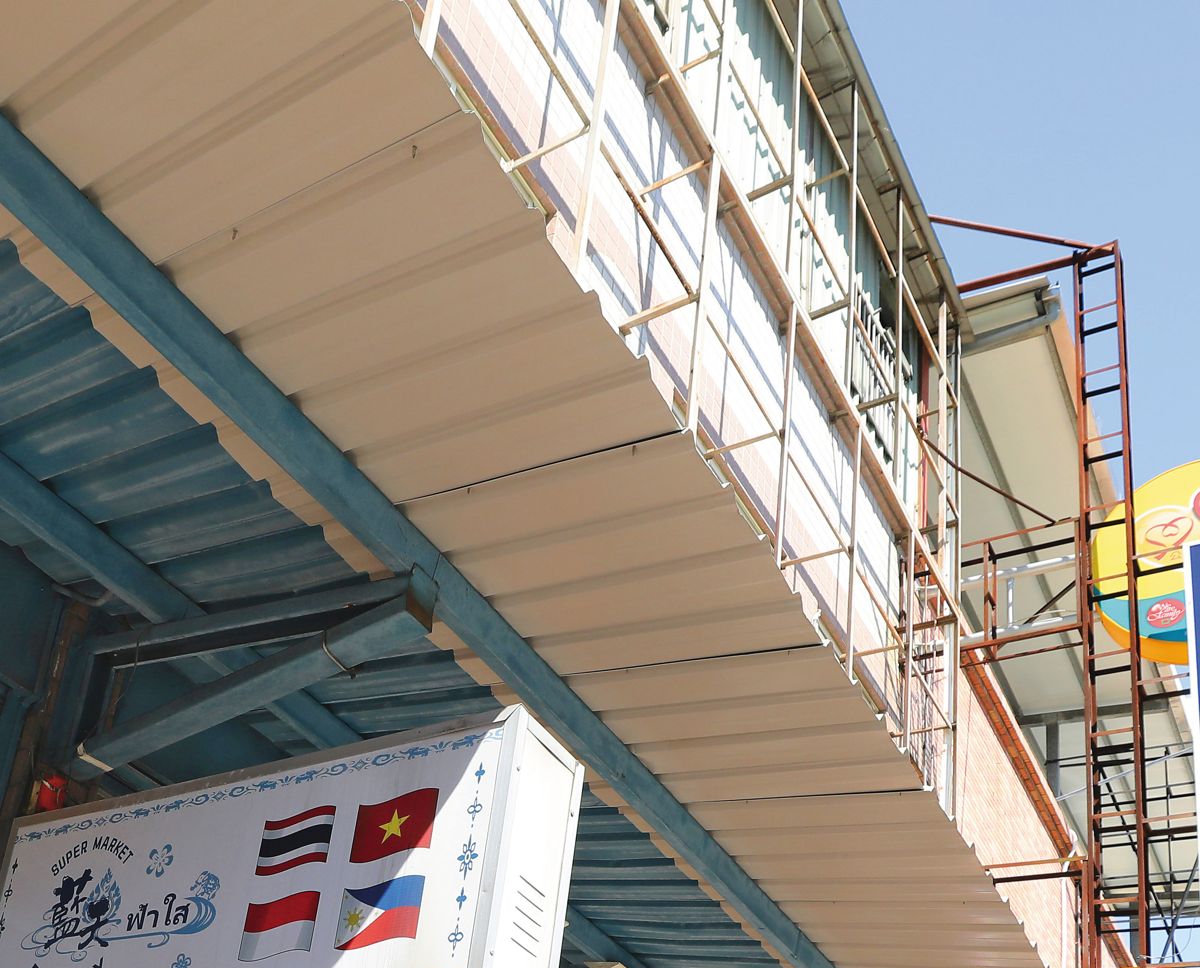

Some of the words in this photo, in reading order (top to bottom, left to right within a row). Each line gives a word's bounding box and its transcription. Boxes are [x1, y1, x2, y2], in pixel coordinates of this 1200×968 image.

[51, 840, 88, 877] SUPER
[92, 836, 135, 865] MARKET
[126, 893, 192, 932] ฟ้าใส
